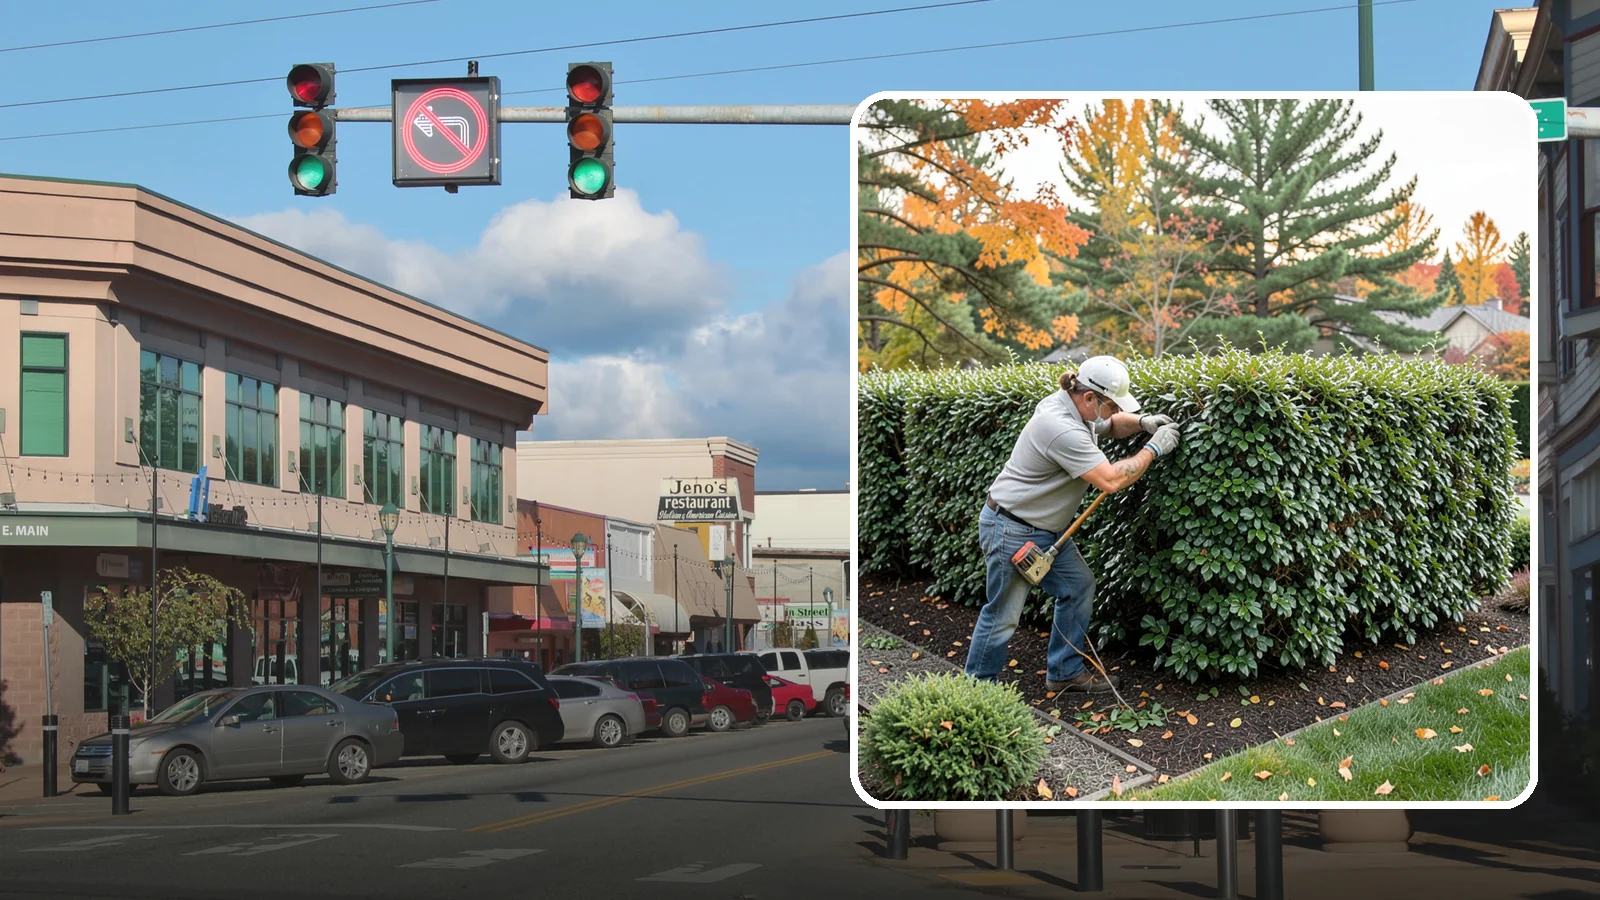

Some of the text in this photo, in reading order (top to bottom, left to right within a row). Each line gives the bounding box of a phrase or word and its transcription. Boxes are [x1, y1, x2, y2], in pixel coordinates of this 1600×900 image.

[670, 480, 727, 494] Jeno's
[665, 496, 731, 508] restaurant
[658, 510, 681, 519] Italian
[685, 510, 714, 519] American
[715, 510, 737, 519] Cuisine
[2, 525, 49, 536] E. MAIN
[797, 607, 829, 617] Street
